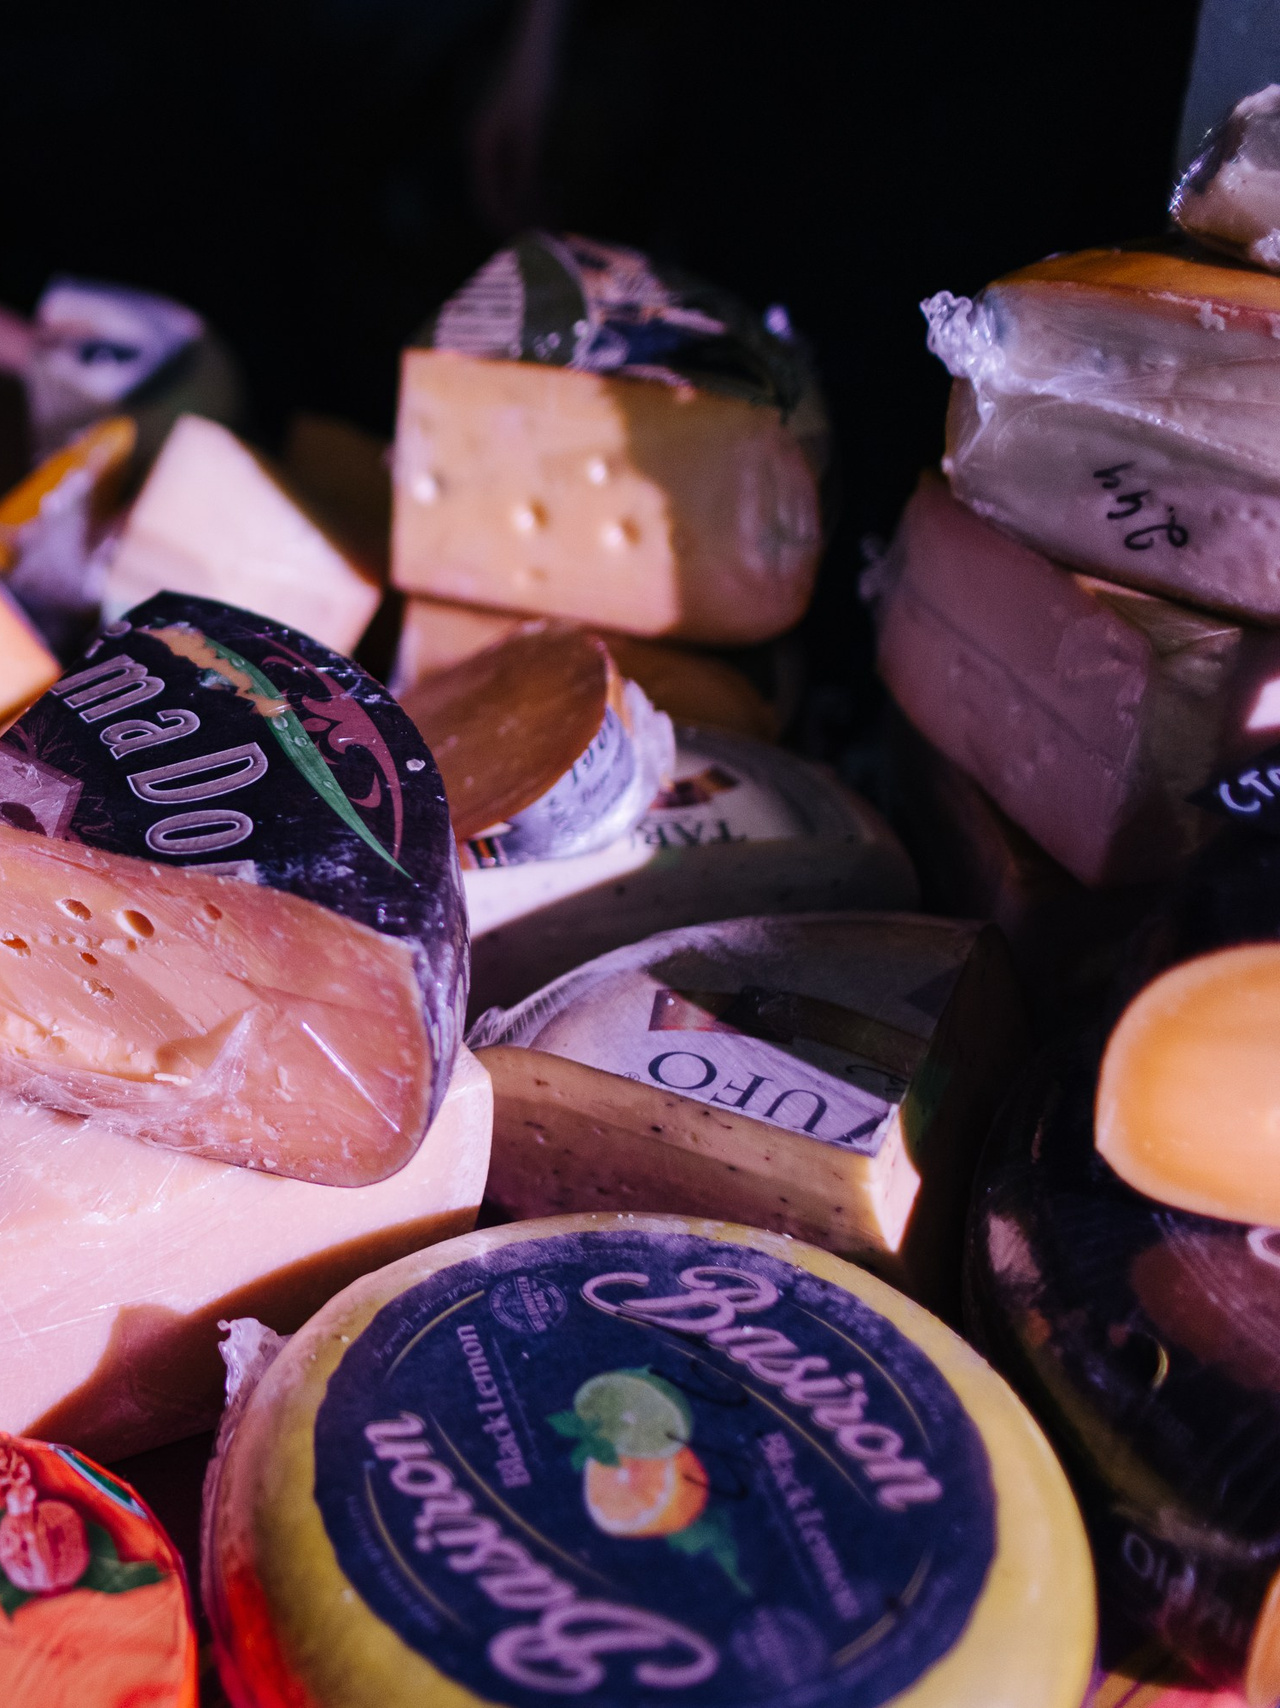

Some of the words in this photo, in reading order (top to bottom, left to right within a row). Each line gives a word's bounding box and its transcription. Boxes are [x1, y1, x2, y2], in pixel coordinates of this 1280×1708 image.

[52, 620, 268, 884] maDo
[456, 1324, 504, 1412] Lemon
[482, 1412, 532, 1488] Black
[581, 1264, 943, 1511] Basiron
[363, 1410, 720, 1696] Basiron
